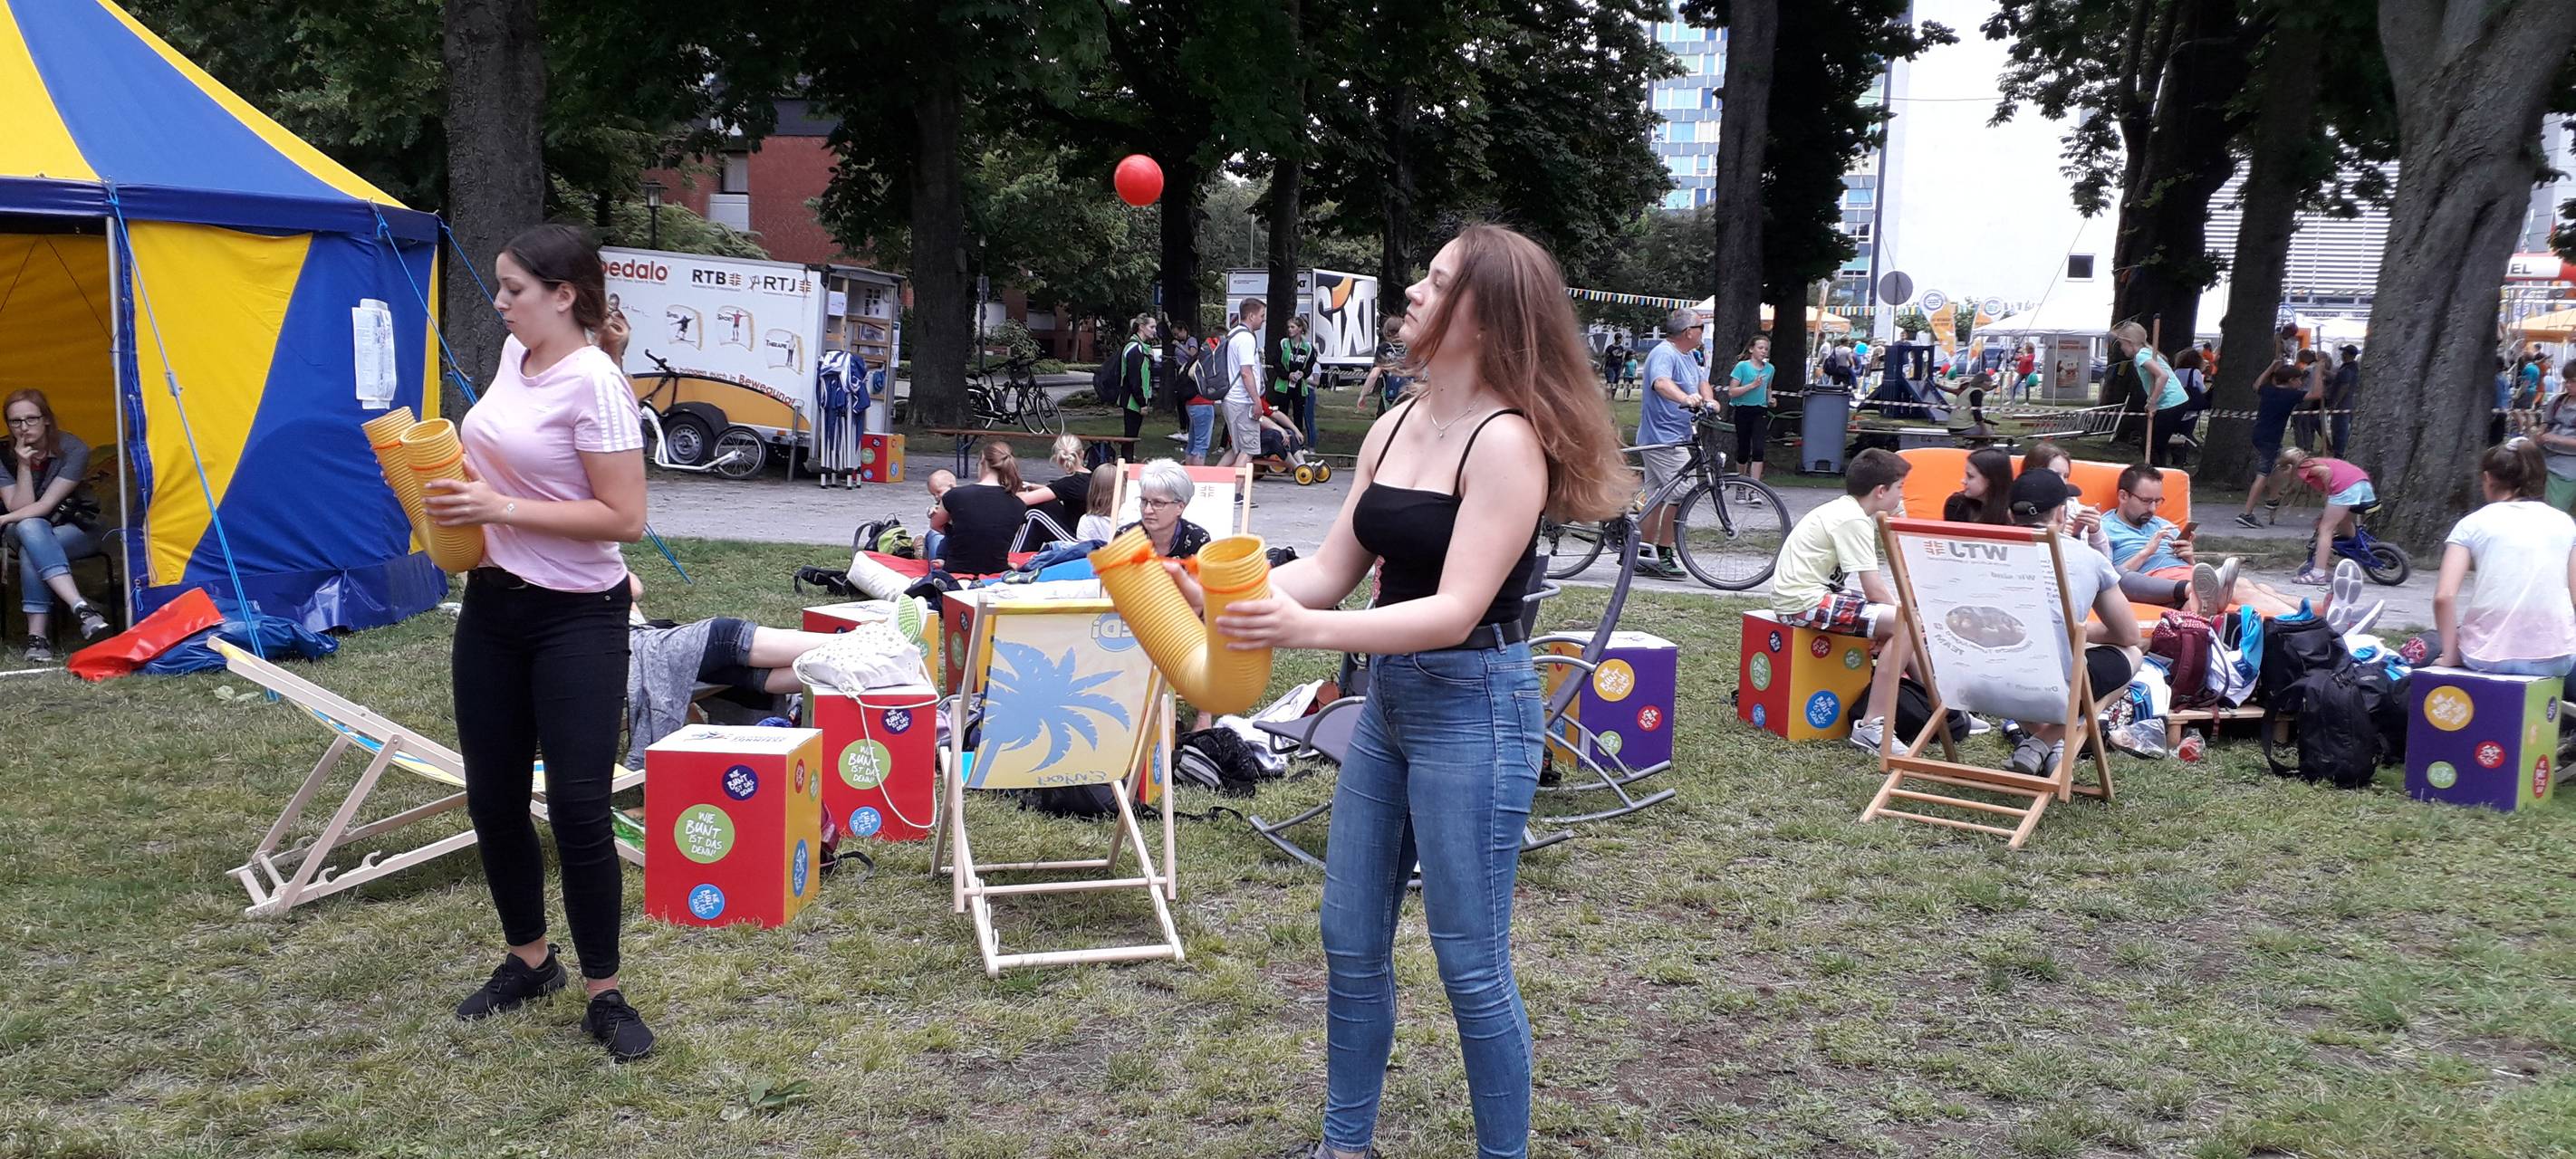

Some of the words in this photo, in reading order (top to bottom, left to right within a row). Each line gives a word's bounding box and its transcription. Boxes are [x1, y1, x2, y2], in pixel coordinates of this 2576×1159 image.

[692, 270, 726, 285] RTB
[763, 276, 795, 292] RTJ
[851, 765, 863, 773] IST
[726, 773, 747, 790] BUNT
[698, 811, 716, 824] WIE
[685, 819, 722, 839] BUNT
[688, 834, 703, 844] IST
[706, 838, 723, 849] DAS
